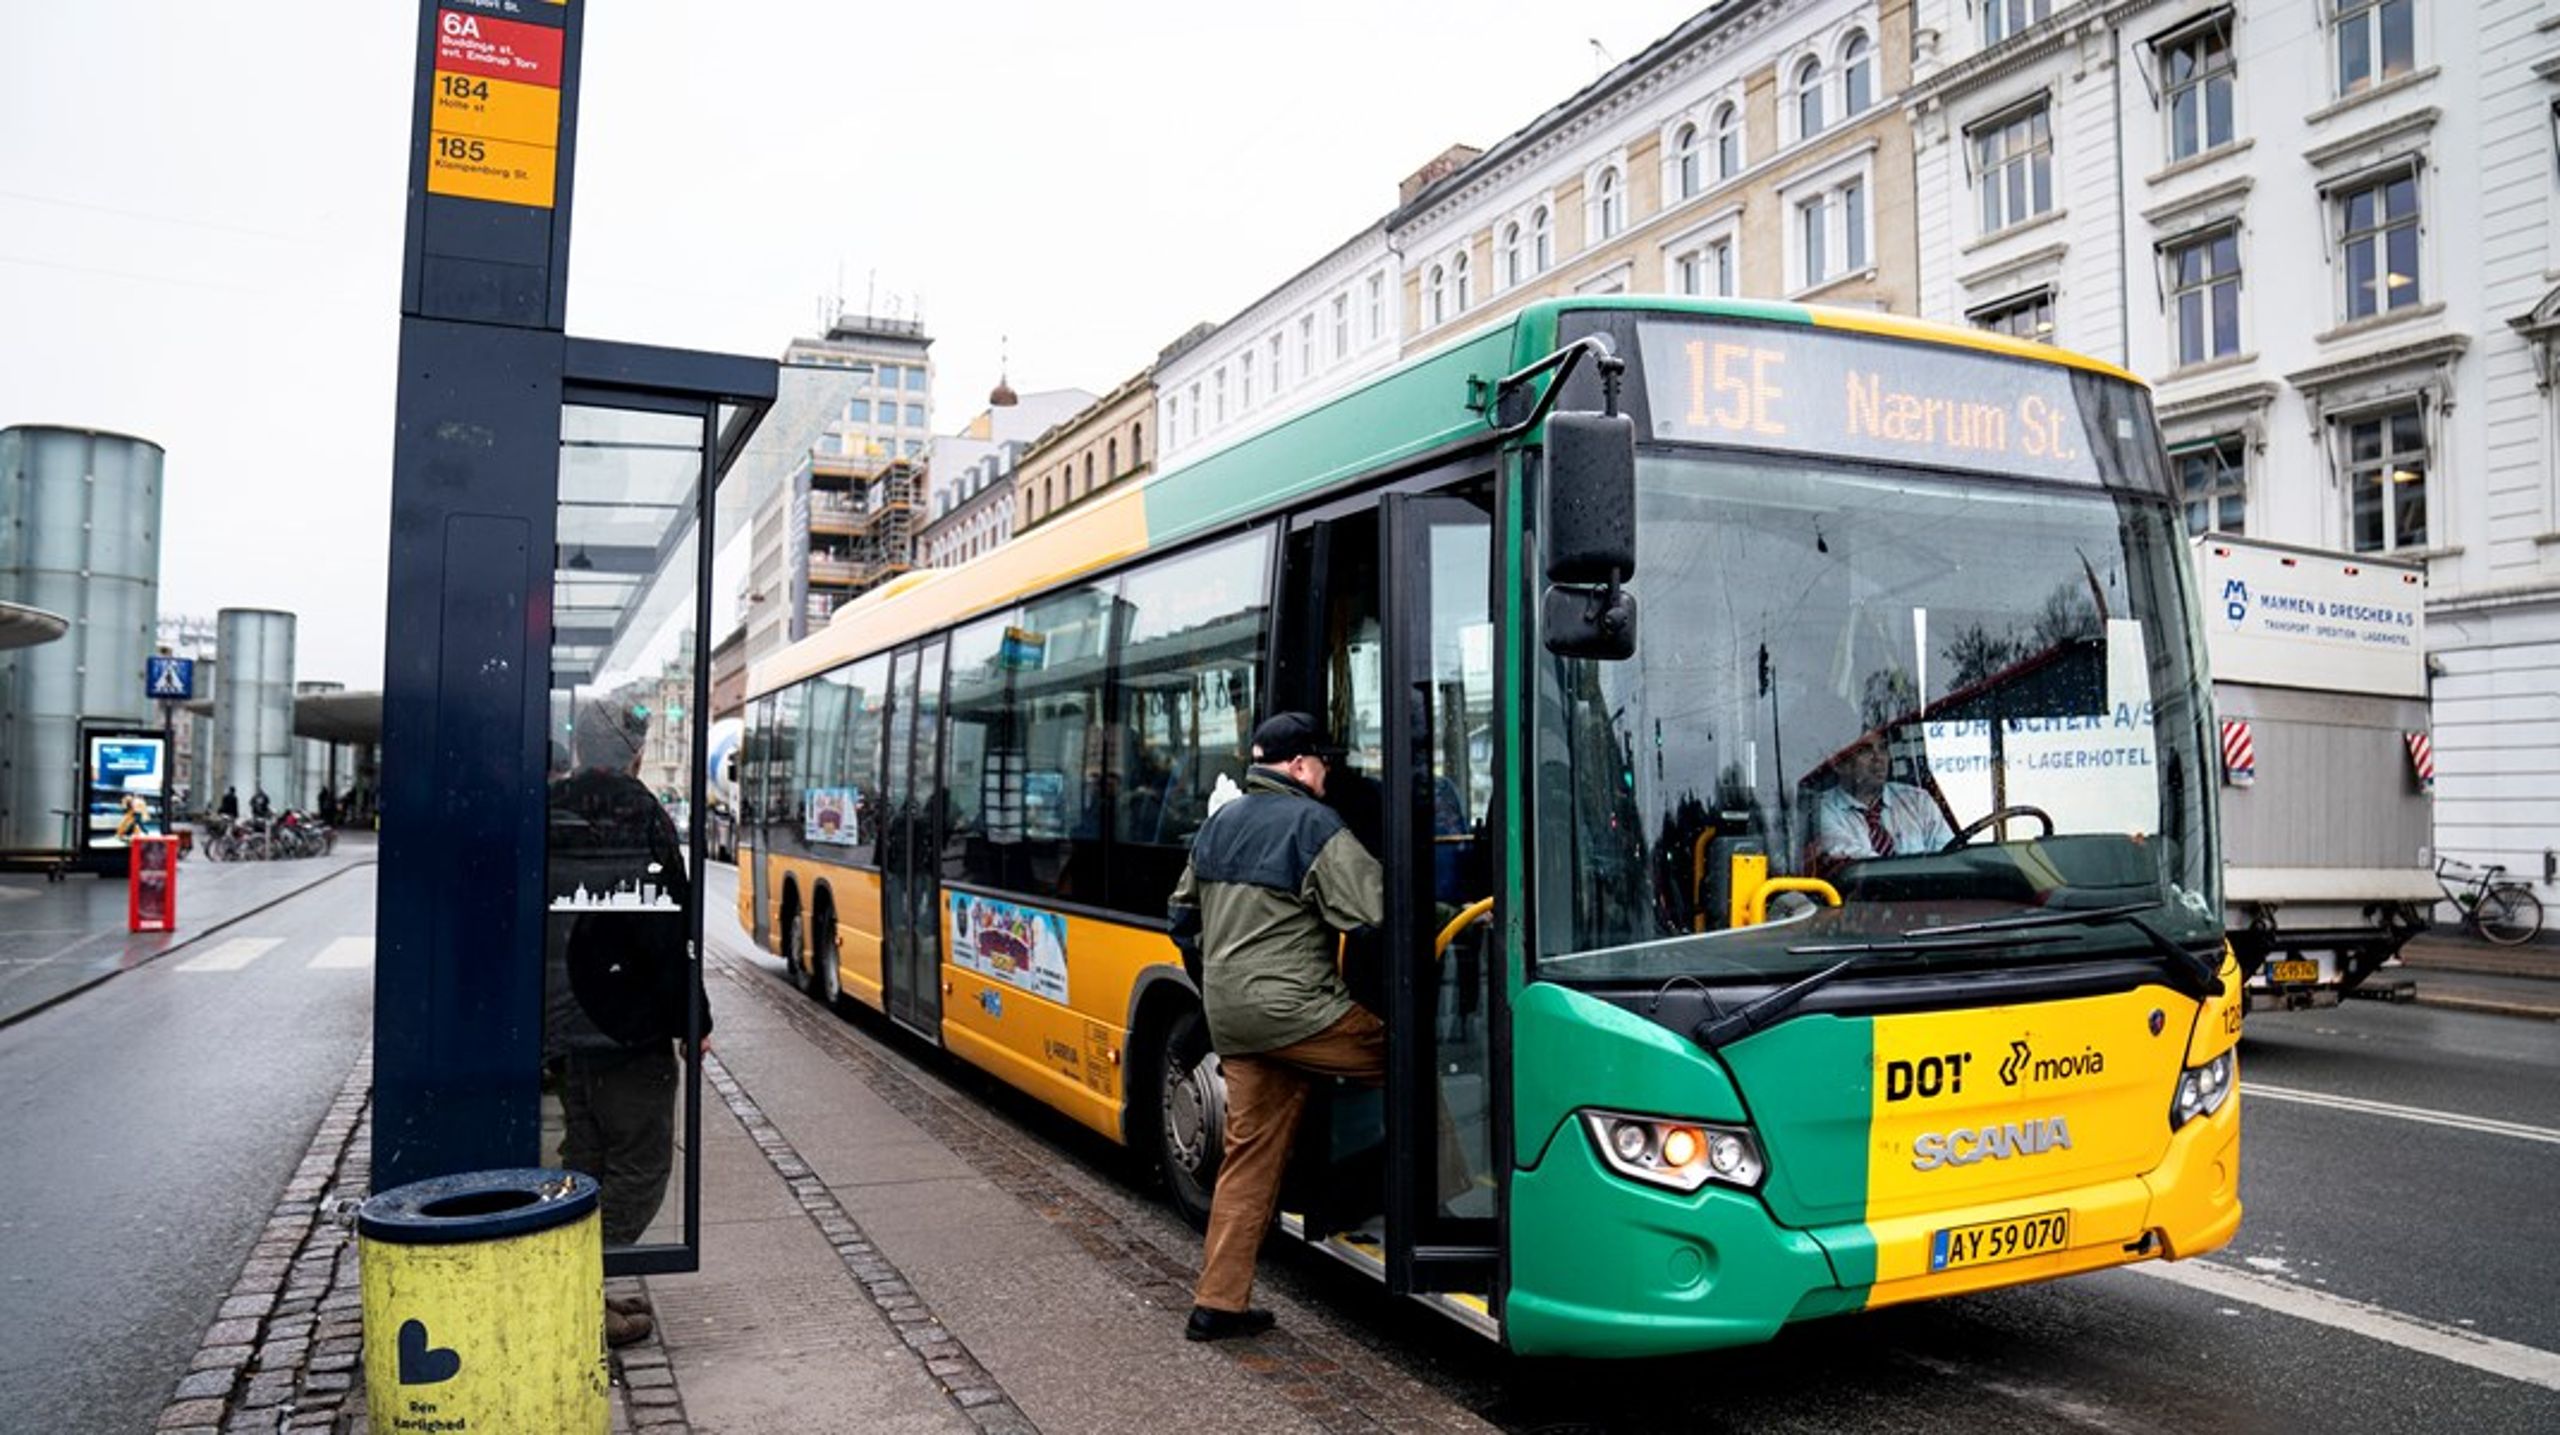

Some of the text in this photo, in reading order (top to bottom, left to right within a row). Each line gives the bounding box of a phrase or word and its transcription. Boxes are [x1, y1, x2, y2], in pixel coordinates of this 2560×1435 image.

[443, 13, 480, 39] 6A
[442, 35, 495, 53] Buddinge
[466, 50, 511, 67] Emdrup
[514, 57, 537, 70] Torv
[441, 76, 489, 101] 184
[437, 136, 485, 162] 185
[1684, 340, 2076, 461] 15E Nærum St.
[2260, 594, 2315, 615] MAMMEN
[2318, 603, 2326, 616] &
[2329, 604, 2393, 623] DRESCHER
[2264, 619, 2310, 634] TRANSPORT
[1954, 715, 2101, 738] DRCHER
[2028, 748, 2152, 769] LAGERHOTEL
[1887, 1052, 1972, 1103] DOT
[2034, 1046, 2104, 1083] movia
[1912, 1117, 2073, 1171] SCANIA
[1949, 1216, 2066, 1263] AY 59 070
[409, 1401, 437, 1413] Ren
